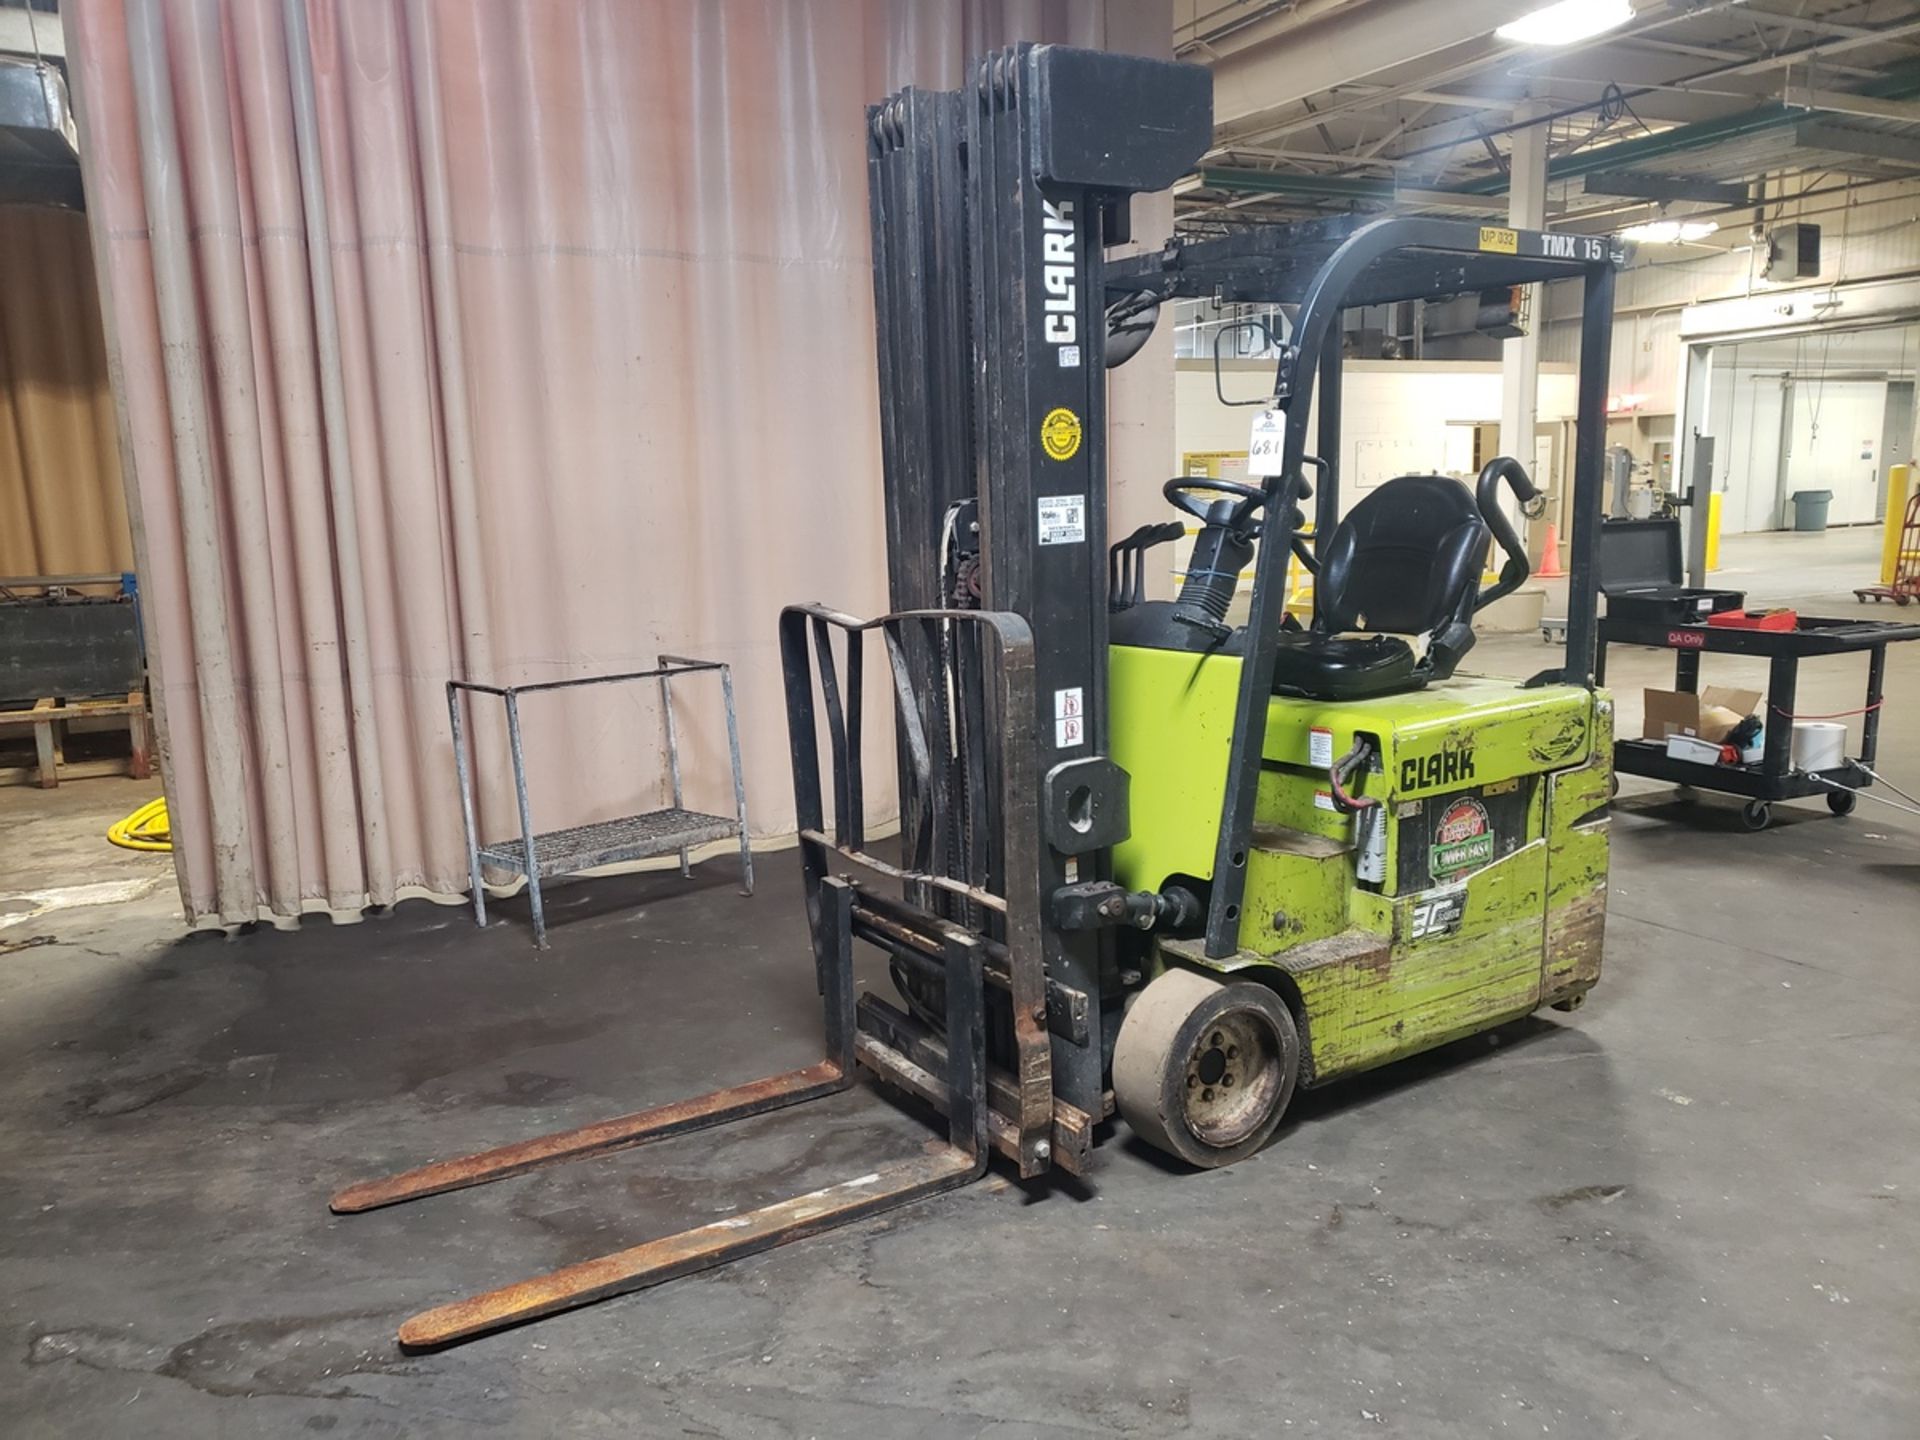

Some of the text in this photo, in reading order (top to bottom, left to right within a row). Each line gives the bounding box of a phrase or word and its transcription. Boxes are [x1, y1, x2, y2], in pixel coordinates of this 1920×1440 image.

[1481, 229, 1514, 246] UP 032
[1541, 234, 1602, 260] TMX 15
[1043, 200, 1076, 343] CLARK
[1252, 440, 1279, 455] 681
[1684, 634, 1704, 646] Only
[1401, 749, 1475, 793] CLARK
